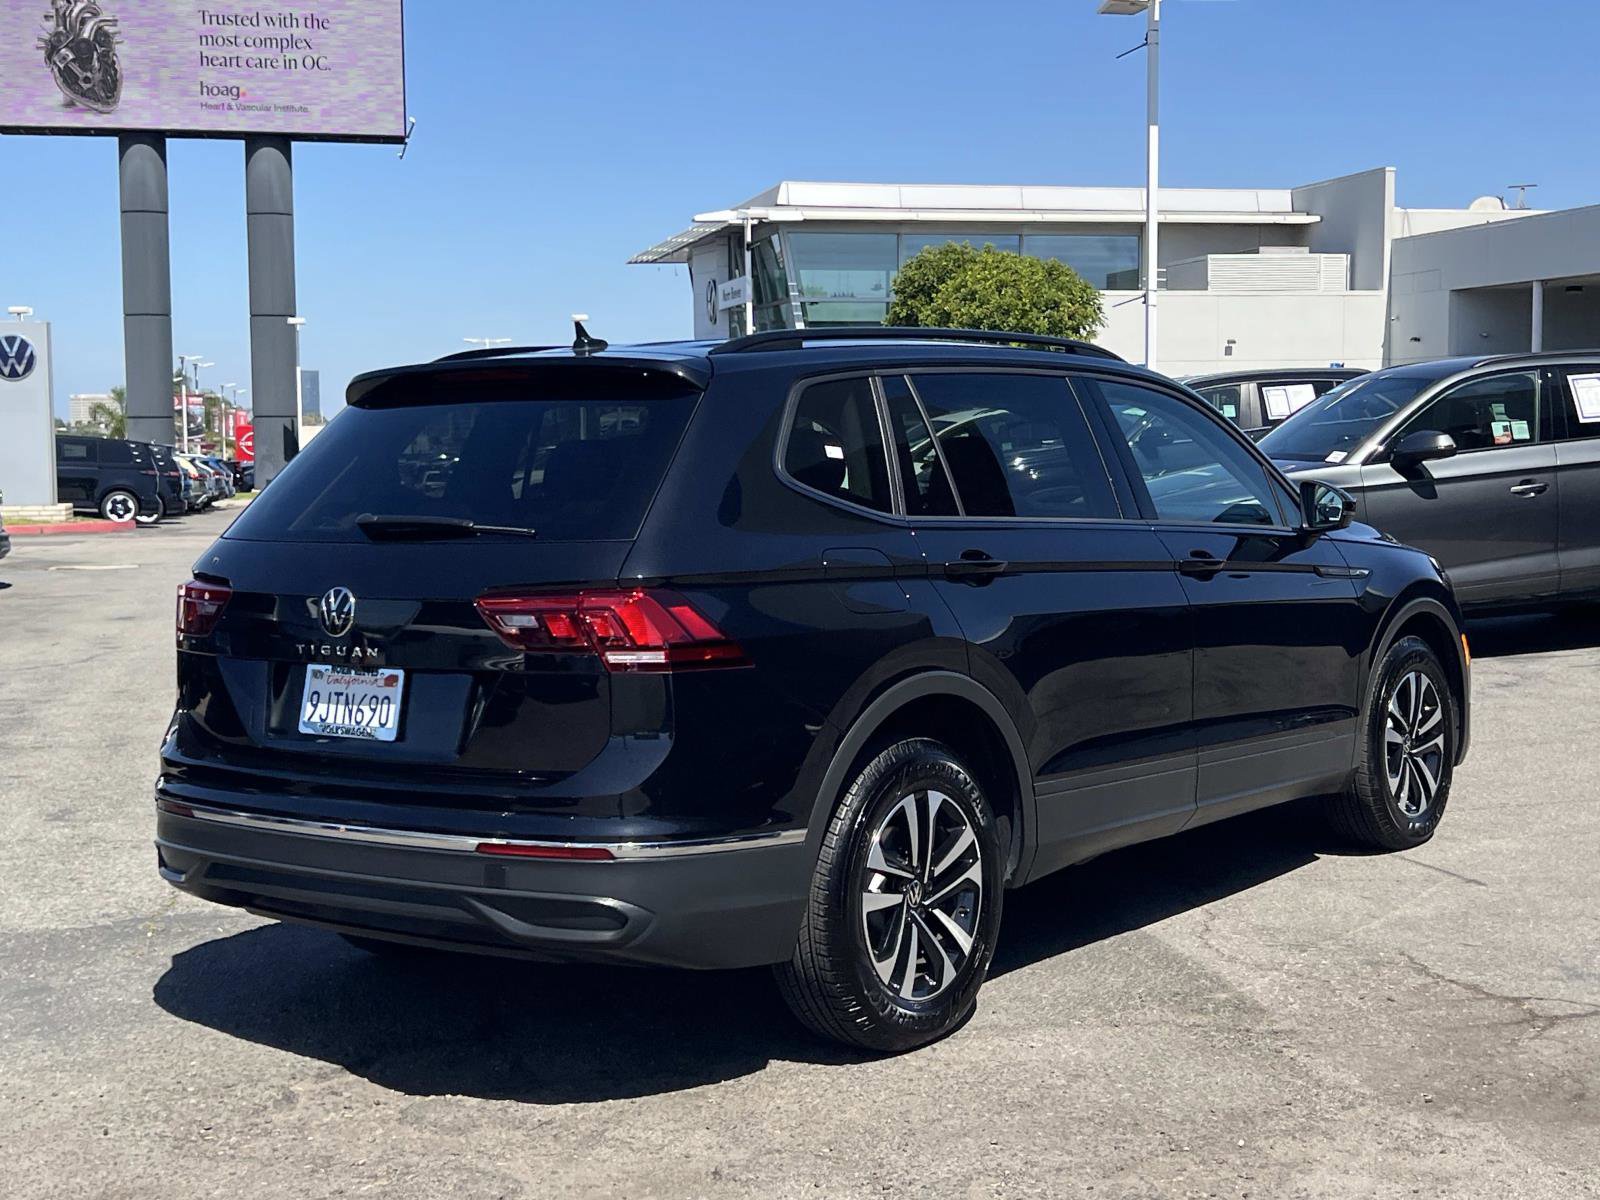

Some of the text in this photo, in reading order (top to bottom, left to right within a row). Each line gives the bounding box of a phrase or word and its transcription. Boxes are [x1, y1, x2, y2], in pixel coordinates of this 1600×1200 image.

[198, 9, 330, 30] Trusted with the
[199, 33, 313, 53] most complex
[199, 50, 332, 71] heart care in OC.
[200, 102, 225, 111] Heart
[227, 102, 234, 111] &
[236, 103, 272, 112] Vascular
[296, 644, 379, 657] TIGUAN
[307, 691, 391, 728] 9JTN690
